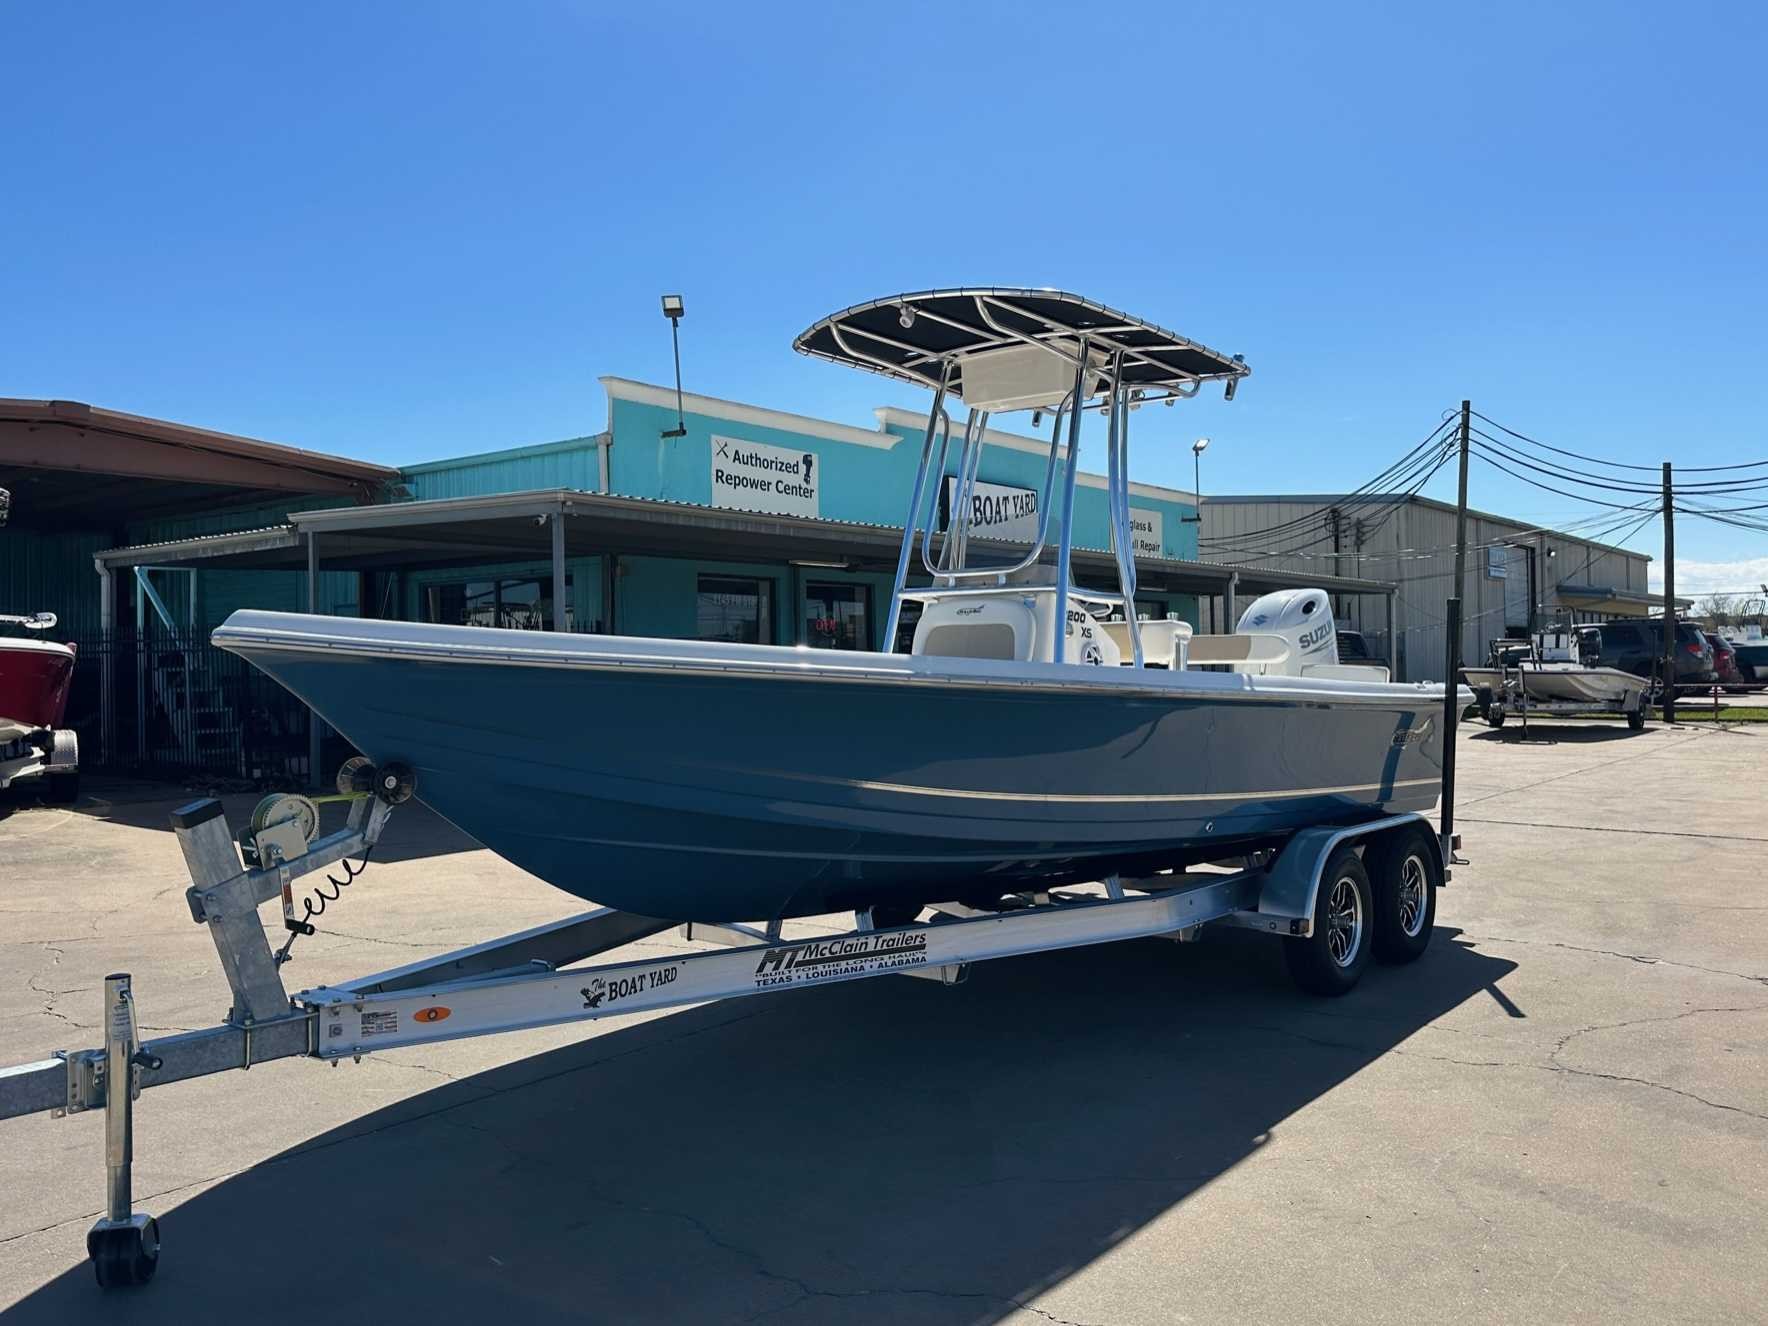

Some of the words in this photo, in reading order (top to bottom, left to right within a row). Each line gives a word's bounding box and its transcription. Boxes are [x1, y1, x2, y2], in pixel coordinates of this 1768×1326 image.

[732, 449, 799, 475] Authorized
[715, 469, 772, 490] Repower
[775, 480, 815, 499] Center
[972, 495, 1009, 527] BOAT
[1013, 492, 1036, 519] YARD
[1129, 520, 1147, 532] glass
[1140, 540, 1160, 552] Repair
[1066, 610, 1086, 623] 200
[1081, 626, 1092, 639] XS
[802, 937, 869, 959] McClain
[873, 932, 927, 950] Trailers
[755, 975, 793, 987] TEXAS
[806, 965, 865, 980] LOUISIANA
[877, 956, 927, 968] ALABAMA
[846, 957, 885, 966] LONG
[607, 974, 646, 1002] BOAT
[649, 966, 677, 988] YARD
